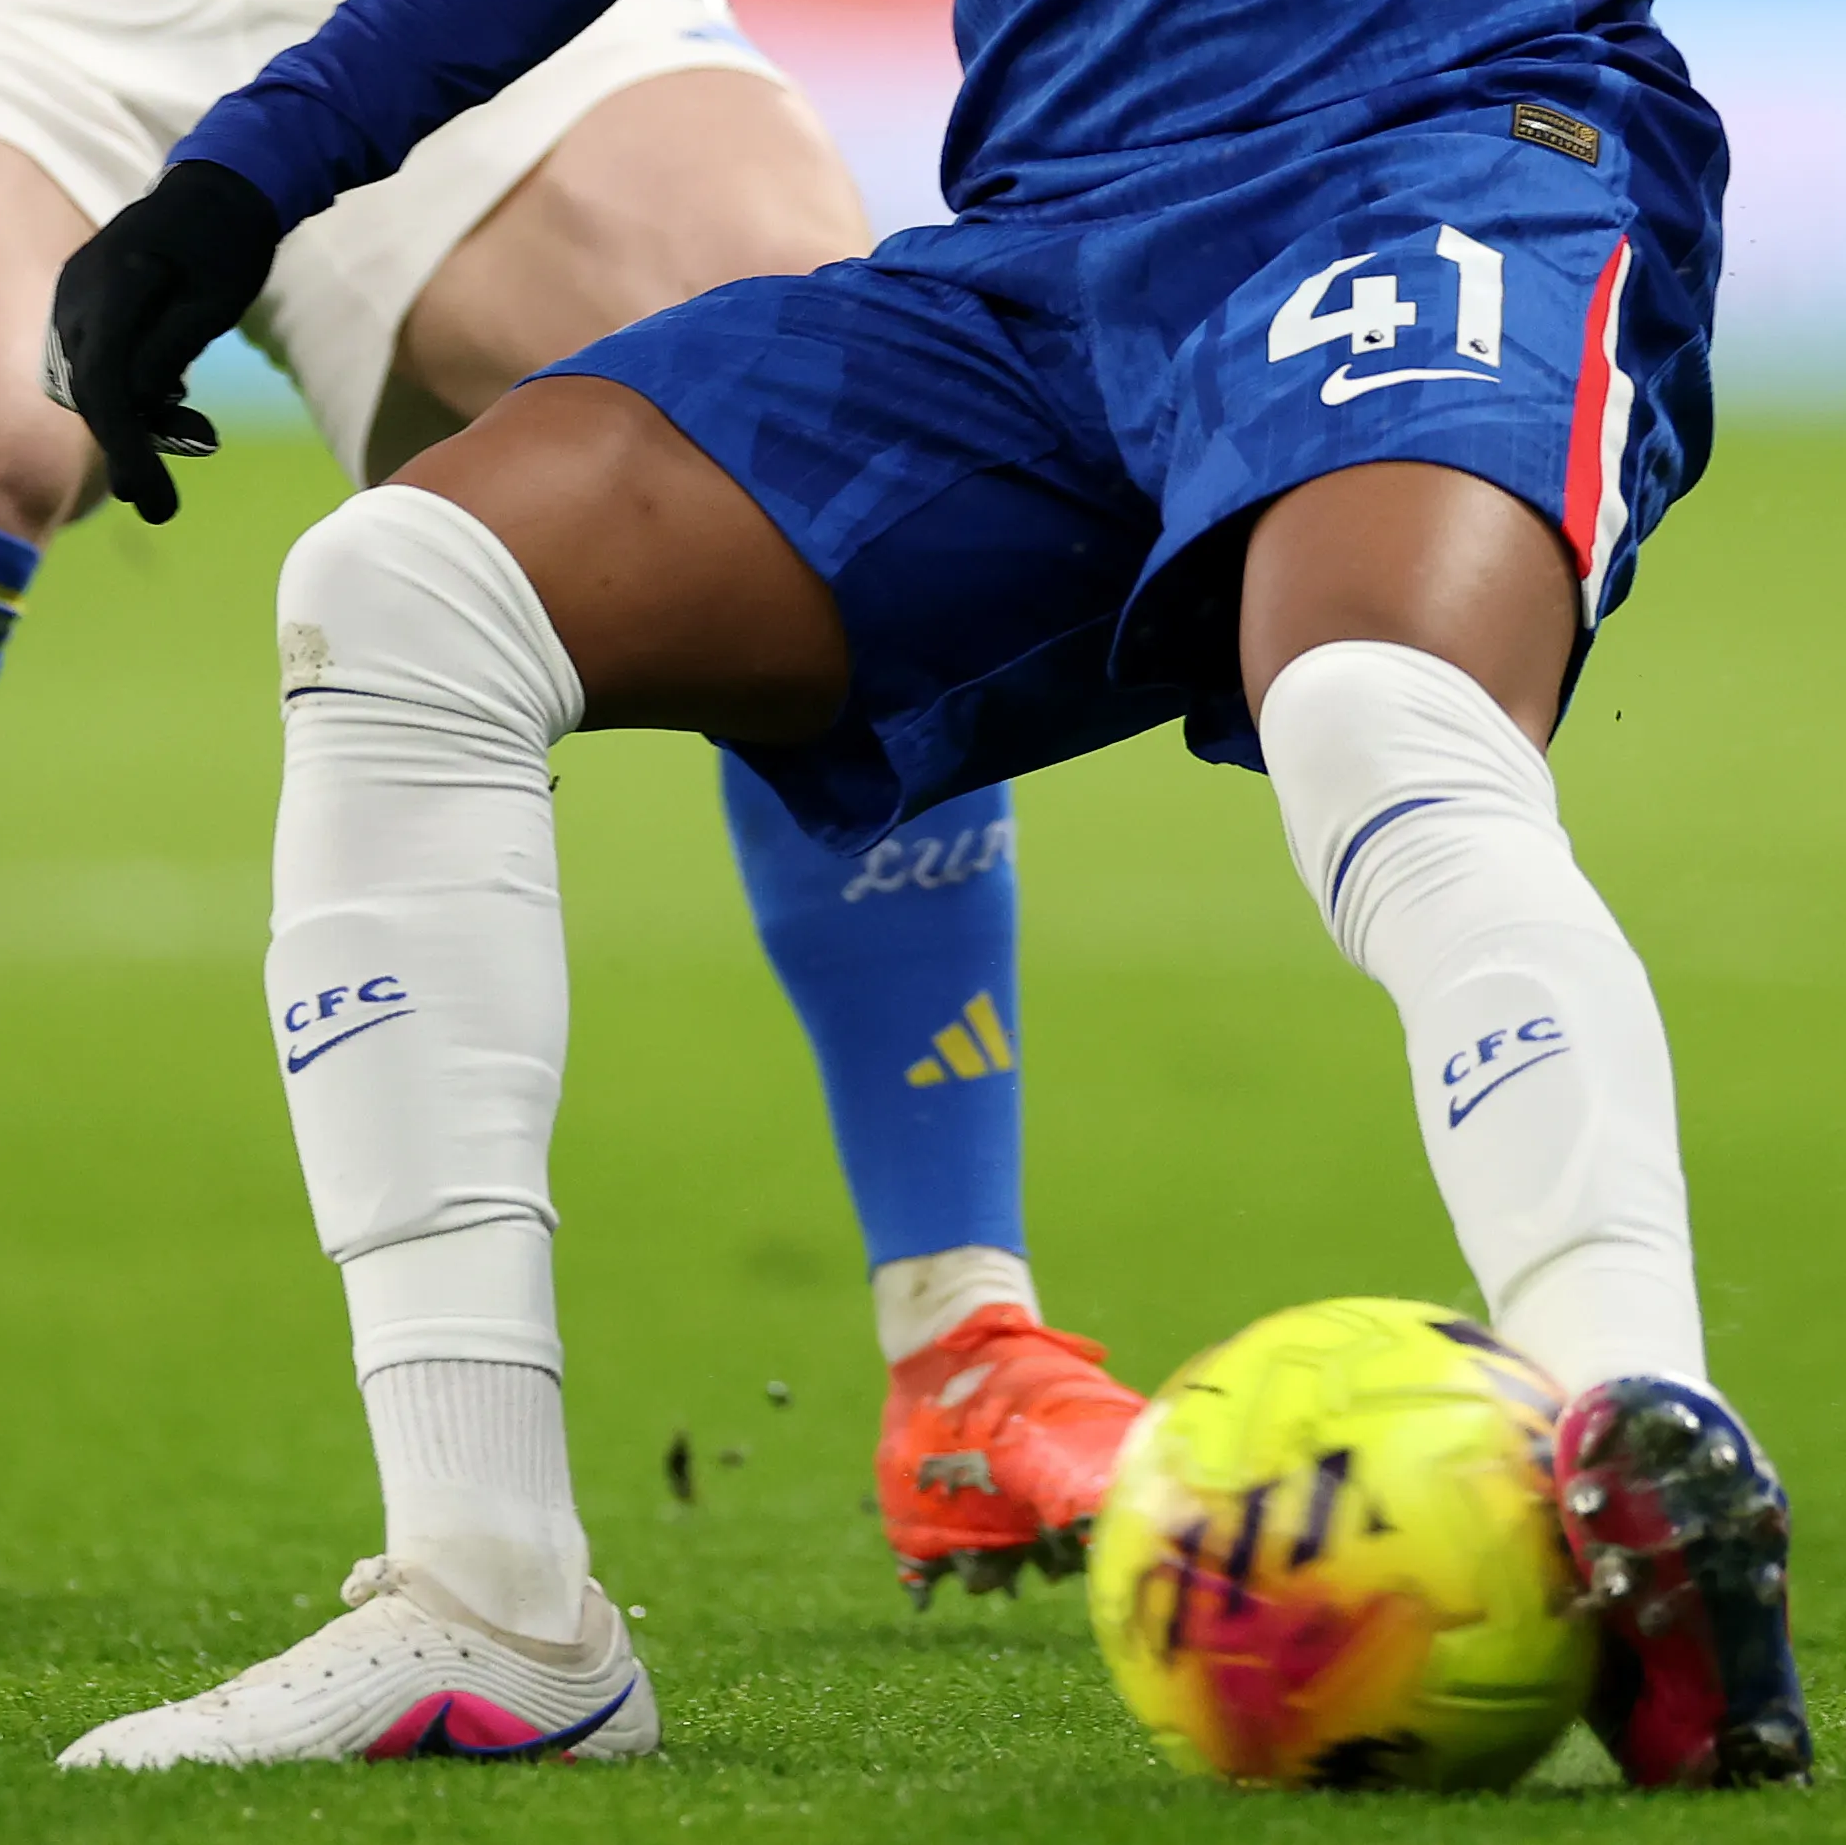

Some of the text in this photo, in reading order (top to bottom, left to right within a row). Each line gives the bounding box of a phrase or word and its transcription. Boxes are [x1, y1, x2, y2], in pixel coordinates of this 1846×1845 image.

[1267, 223, 1505, 369] 41
[285, 975, 407, 1033] CFC
[1443, 1016, 1564, 1087] CFC
